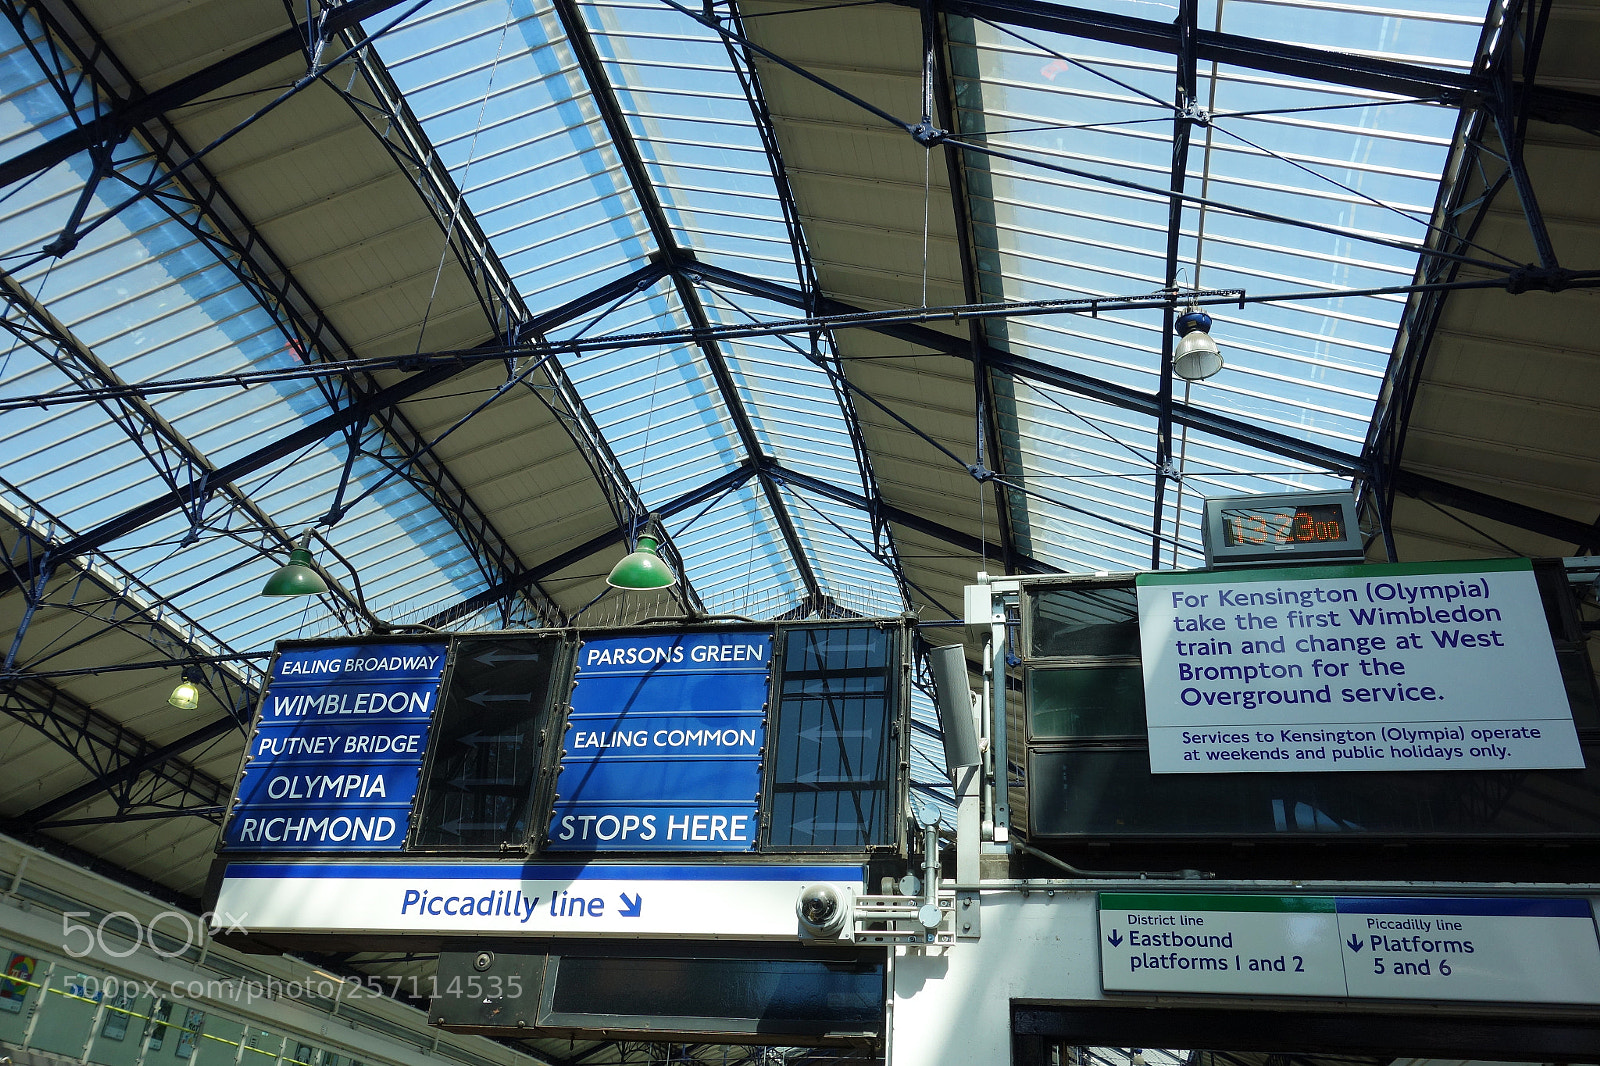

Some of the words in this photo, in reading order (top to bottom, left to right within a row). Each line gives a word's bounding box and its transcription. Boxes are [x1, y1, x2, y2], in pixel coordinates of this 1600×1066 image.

[1171, 591, 1209, 609] For
[1218, 587, 1358, 608] Kensington
[1366, 577, 1490, 604] (Olympia)
[1173, 614, 1226, 632] take
[1234, 612, 1278, 630] the
[1286, 610, 1341, 628] first
[1349, 604, 1502, 626] Wimbledon
[1175, 637, 1232, 656] train
[1241, 635, 1286, 655] and
[1295, 634, 1386, 656] change
[1396, 632, 1424, 650] at
[1430, 629, 1505, 649] West
[281, 659, 340, 675] EALING
[344, 655, 440, 673] BROADWAY
[587, 646, 684, 666] PARSONS
[691, 644, 763, 662] GREEN
[1178, 661, 1303, 684] Brompton
[1311, 658, 1349, 678] for
[1359, 657, 1406, 677] the
[273, 691, 431, 717] WIMBLEDON
[1180, 684, 1332, 710] Overground
[1341, 682, 1445, 703] service.
[258, 736, 340, 756] PUTNEY
[344, 734, 421, 754] BRIDGE
[574, 731, 648, 749] EALING
[653, 729, 756, 747] COMMON
[1182, 730, 1250, 744] Services
[1255, 731, 1275, 743] to
[1280, 729, 1376, 745] Kensington
[1381, 725, 1465, 744] (Olympia)
[1470, 726, 1542, 742] operate
[1183, 749, 1200, 761] at
[1206, 747, 1290, 761] weekends
[1295, 746, 1326, 760] and
[1332, 745, 1385, 762] public
[1390, 744, 1464, 761] holidays
[1469, 743, 1512, 760] only.
[267, 774, 387, 800] OLYMPIA
[239, 816, 396, 843] RICHMOND
[558, 815, 657, 841] STOPS
[666, 814, 749, 841] HERE
[401, 889, 540, 924] Piccadilly
[550, 891, 605, 918] line
[1128, 914, 1176, 926] District
[1180, 915, 1204, 926] line
[1366, 918, 1431, 933] Piccadilly
[1436, 919, 1463, 931] line
[1129, 930, 1233, 948] Eastbound
[1370, 934, 1475, 953] Platforms
[1130, 952, 1228, 972] platforms
[1248, 955, 1286, 972] and
[1292, 955, 1305, 973] 2
[1373, 957, 1385, 975] 5
[1393, 959, 1431, 976] and
[1438, 959, 1452, 977] 6
